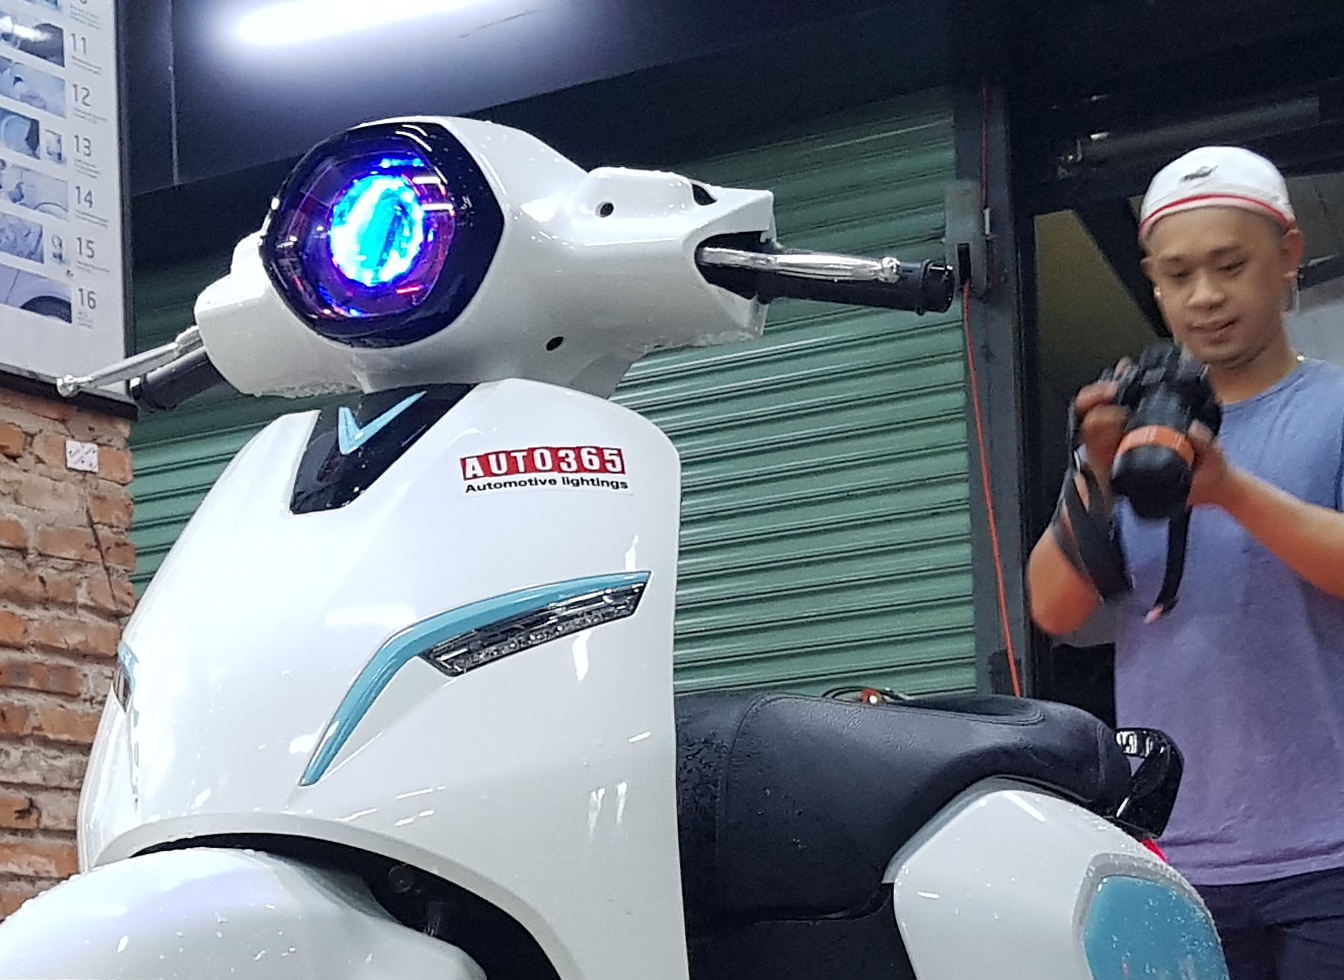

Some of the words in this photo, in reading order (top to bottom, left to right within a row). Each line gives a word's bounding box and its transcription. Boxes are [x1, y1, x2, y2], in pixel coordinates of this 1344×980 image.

[71, 33, 87, 55] 11
[72, 83, 91, 107] 12
[74, 134, 92, 157] 13
[75, 185, 94, 209] 14
[77, 237, 95, 259] 15
[78, 288, 97, 310] 16
[464, 447, 624, 478] AUTO365
[465, 478, 557, 493] Automotive
[562, 476, 629, 490] lightings
